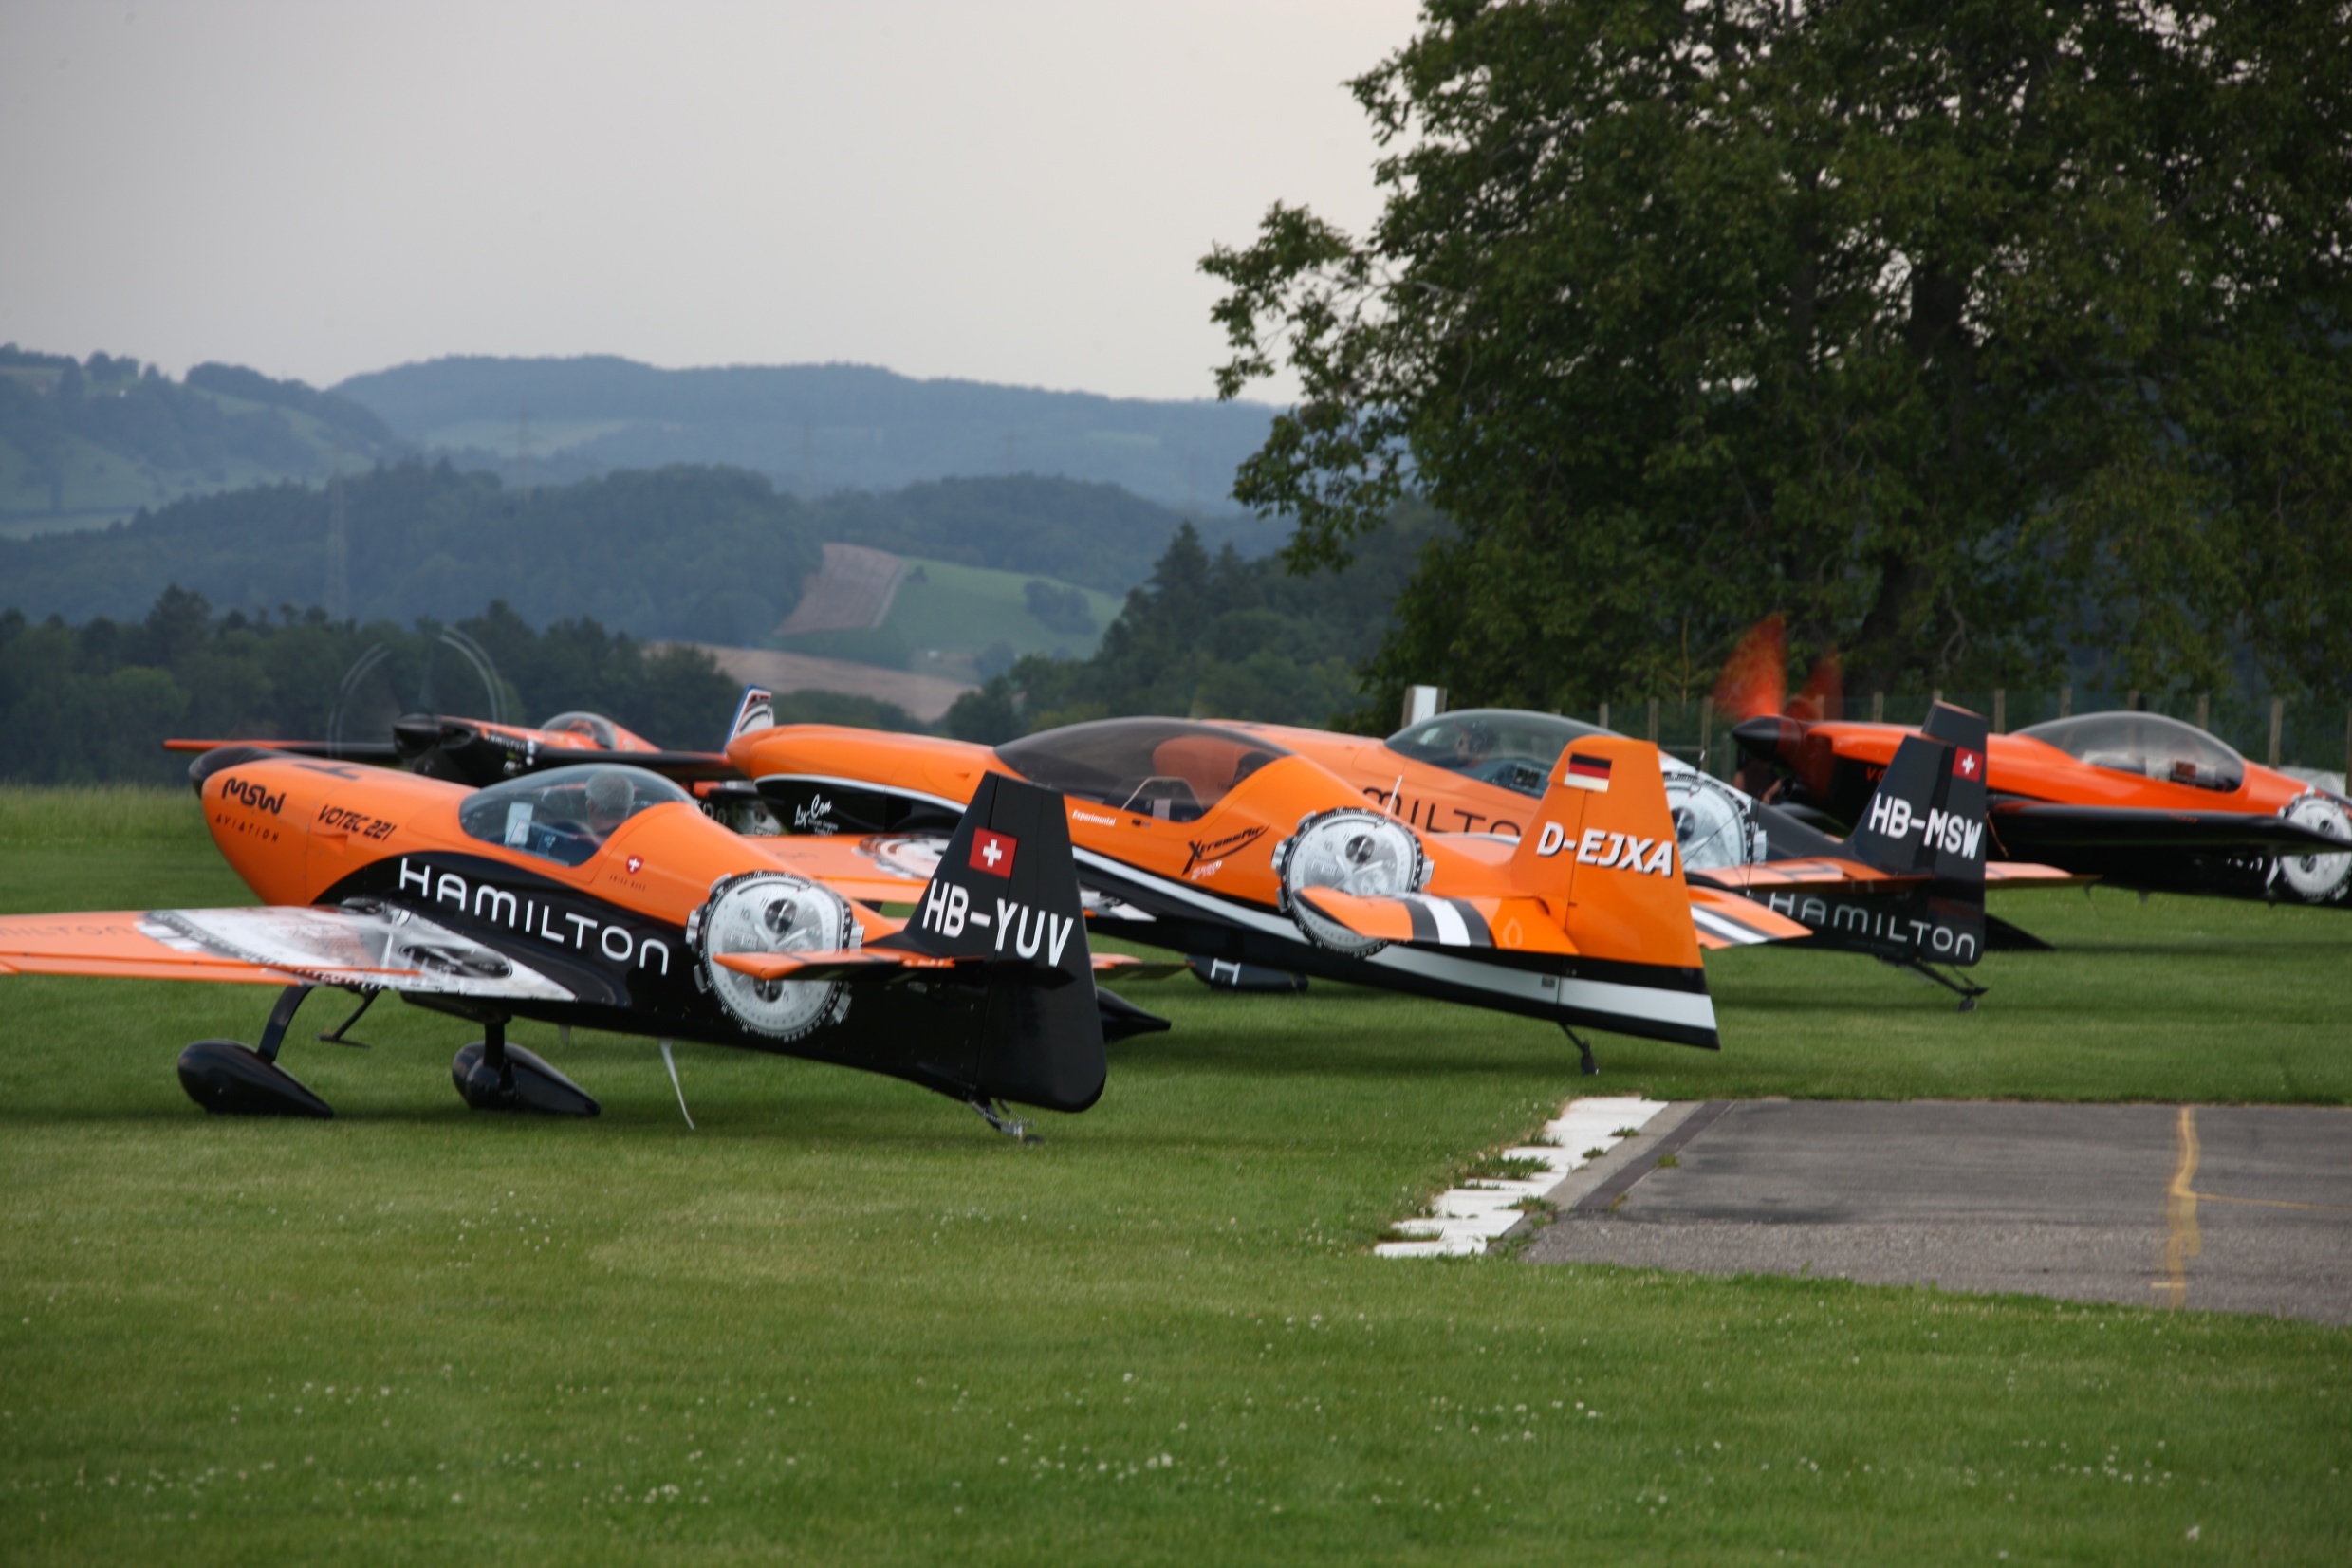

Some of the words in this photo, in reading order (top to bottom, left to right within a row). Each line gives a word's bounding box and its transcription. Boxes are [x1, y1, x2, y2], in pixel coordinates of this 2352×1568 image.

[221, 777, 287, 815] MSW
[317, 804, 370, 833] VOTEC
[362, 816, 398, 842] 221
[1072, 809, 1117, 827] Experimental
[215, 813, 280, 843] AVIATION
[1536, 821, 1673, 878] D-EJXA
[1869, 792, 1983, 860] HB-MSW
[399, 857, 670, 976] HAMILTON
[922, 878, 1075, 968] HB-YUV
[1769, 892, 1976, 962] HAMILTON
